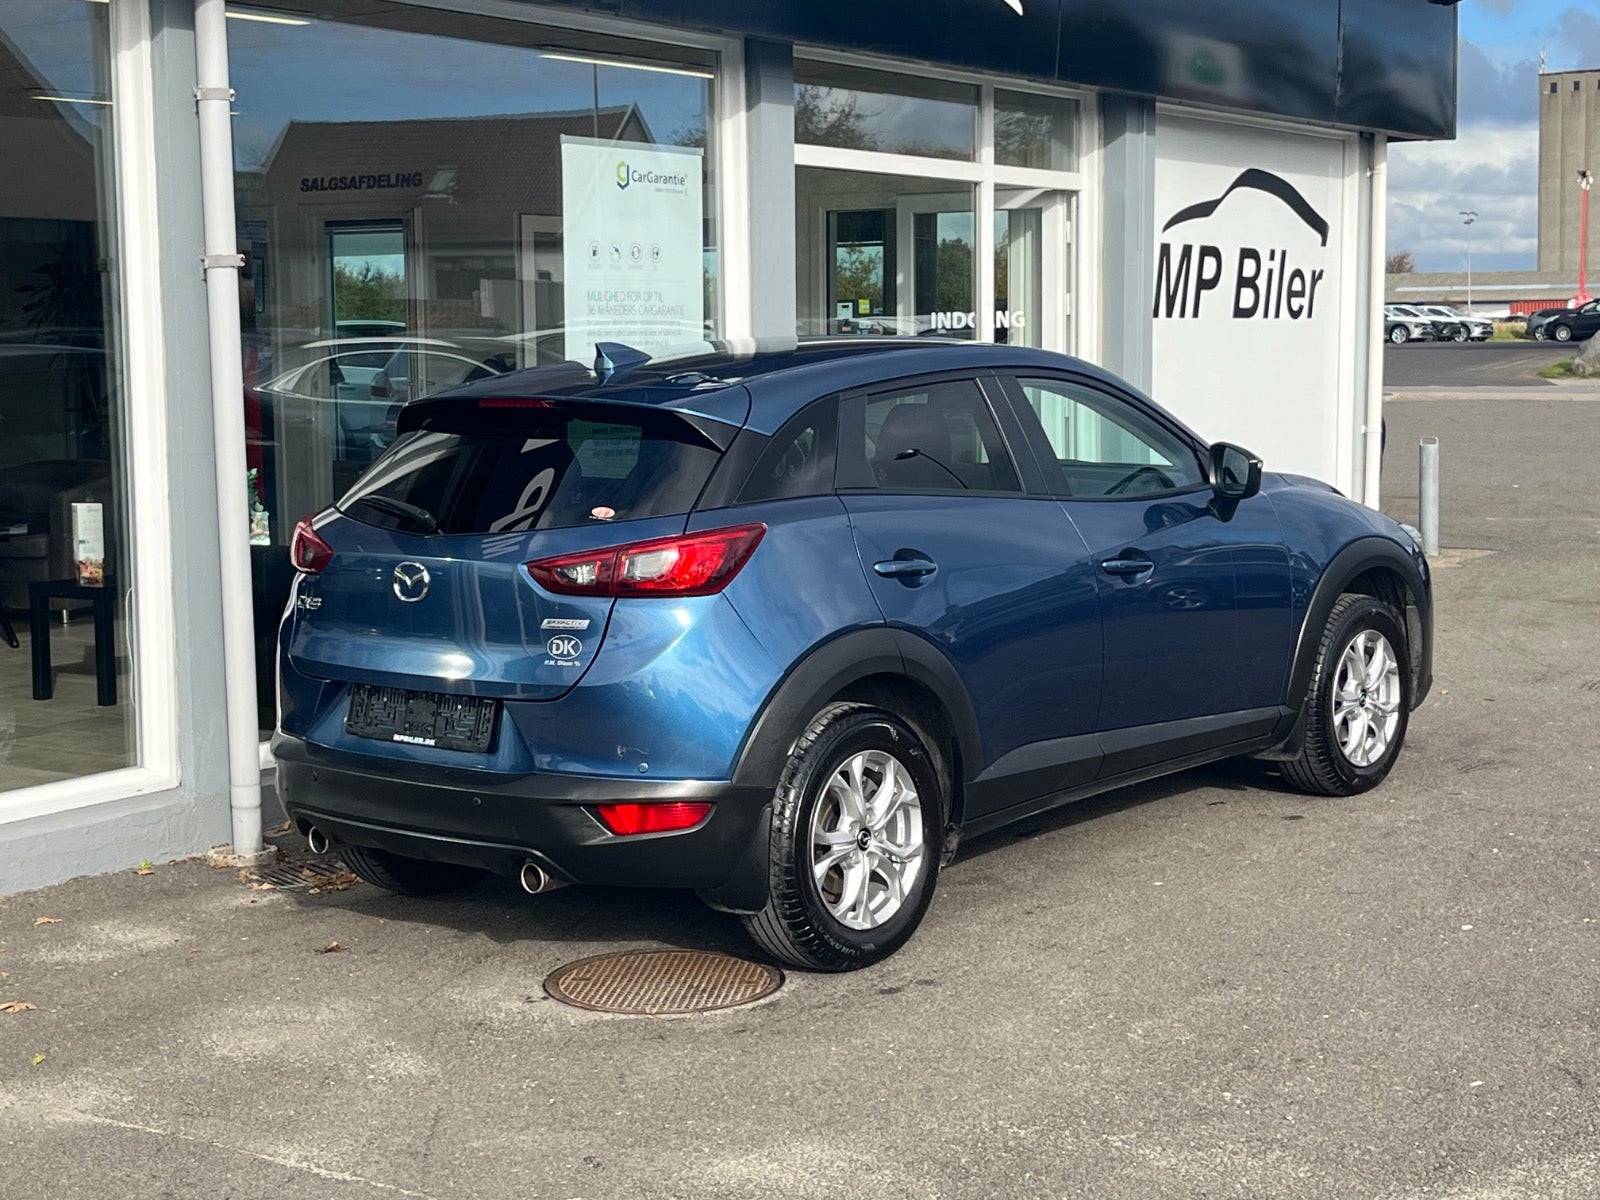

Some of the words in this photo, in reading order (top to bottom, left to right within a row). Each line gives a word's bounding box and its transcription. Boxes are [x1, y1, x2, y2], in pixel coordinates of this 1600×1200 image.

[300, 172, 423, 192] SALGSAFDELING
[631, 170, 686, 186] CarGarantie
[1152, 243, 1222, 318] MP
[1233, 247, 1324, 320] Biler
[587, 291, 625, 303] MULIGHED
[626, 291, 642, 303] FOR
[930, 311, 1025, 329] INDNG
[552, 639, 577, 656] DK
